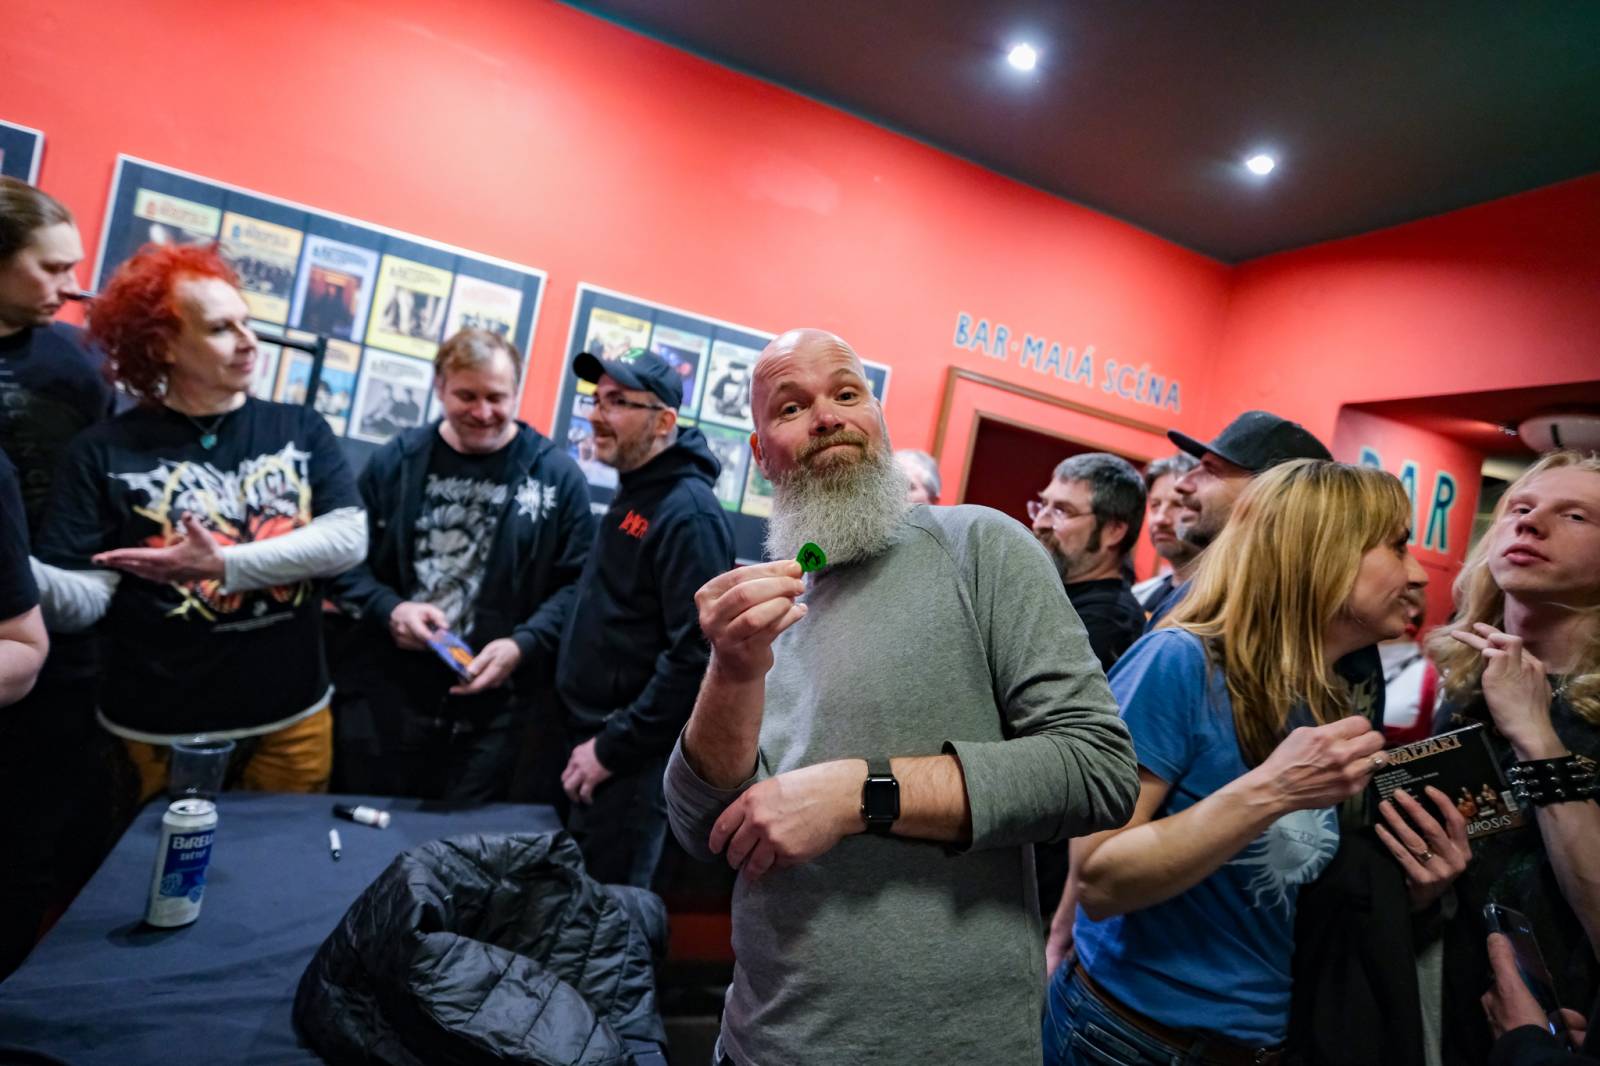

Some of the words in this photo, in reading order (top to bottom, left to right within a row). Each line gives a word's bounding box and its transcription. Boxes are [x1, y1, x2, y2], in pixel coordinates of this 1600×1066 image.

[1102, 359, 1182, 412] SCÉNA
[1358, 446, 1456, 555] AR
[1466, 814, 1512, 835] UROSIS
